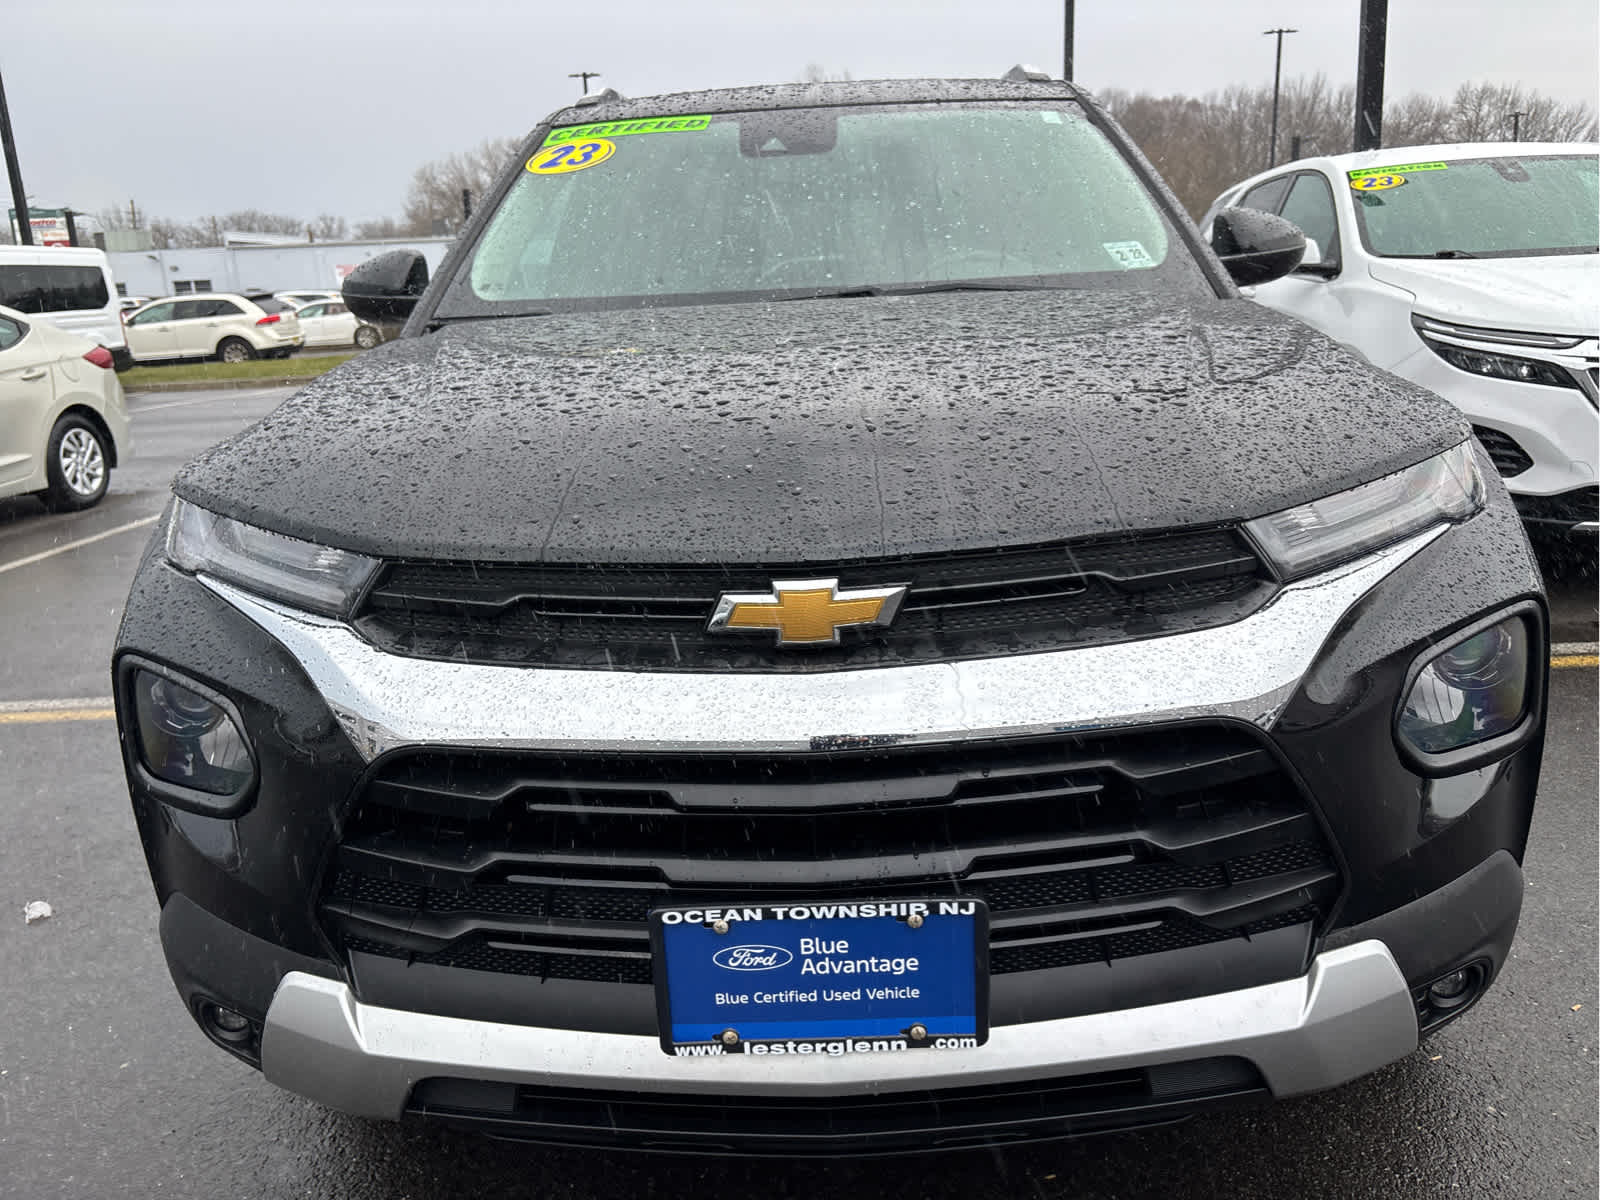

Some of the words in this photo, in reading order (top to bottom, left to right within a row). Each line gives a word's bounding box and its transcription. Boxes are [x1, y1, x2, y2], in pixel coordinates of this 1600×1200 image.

[550, 119, 705, 141] CERTIFIED
[539, 143, 602, 169] 23
[1352, 163, 1444, 177] NAVIGATION
[1363, 176, 1393, 188] 23
[661, 908, 763, 925] OCEAN
[771, 903, 930, 921] TOWNSHIP,
[939, 902, 976, 916] NJ
[800, 937, 849, 955] Blue
[728, 948, 778, 967] Ford
[801, 956, 919, 975] Advantage
[715, 992, 749, 1005] Blue
[753, 990, 818, 1003] Certified
[823, 988, 861, 1001] Used
[866, 987, 920, 1000] Vehicle
[743, 1038, 907, 1057] lesterglenn
